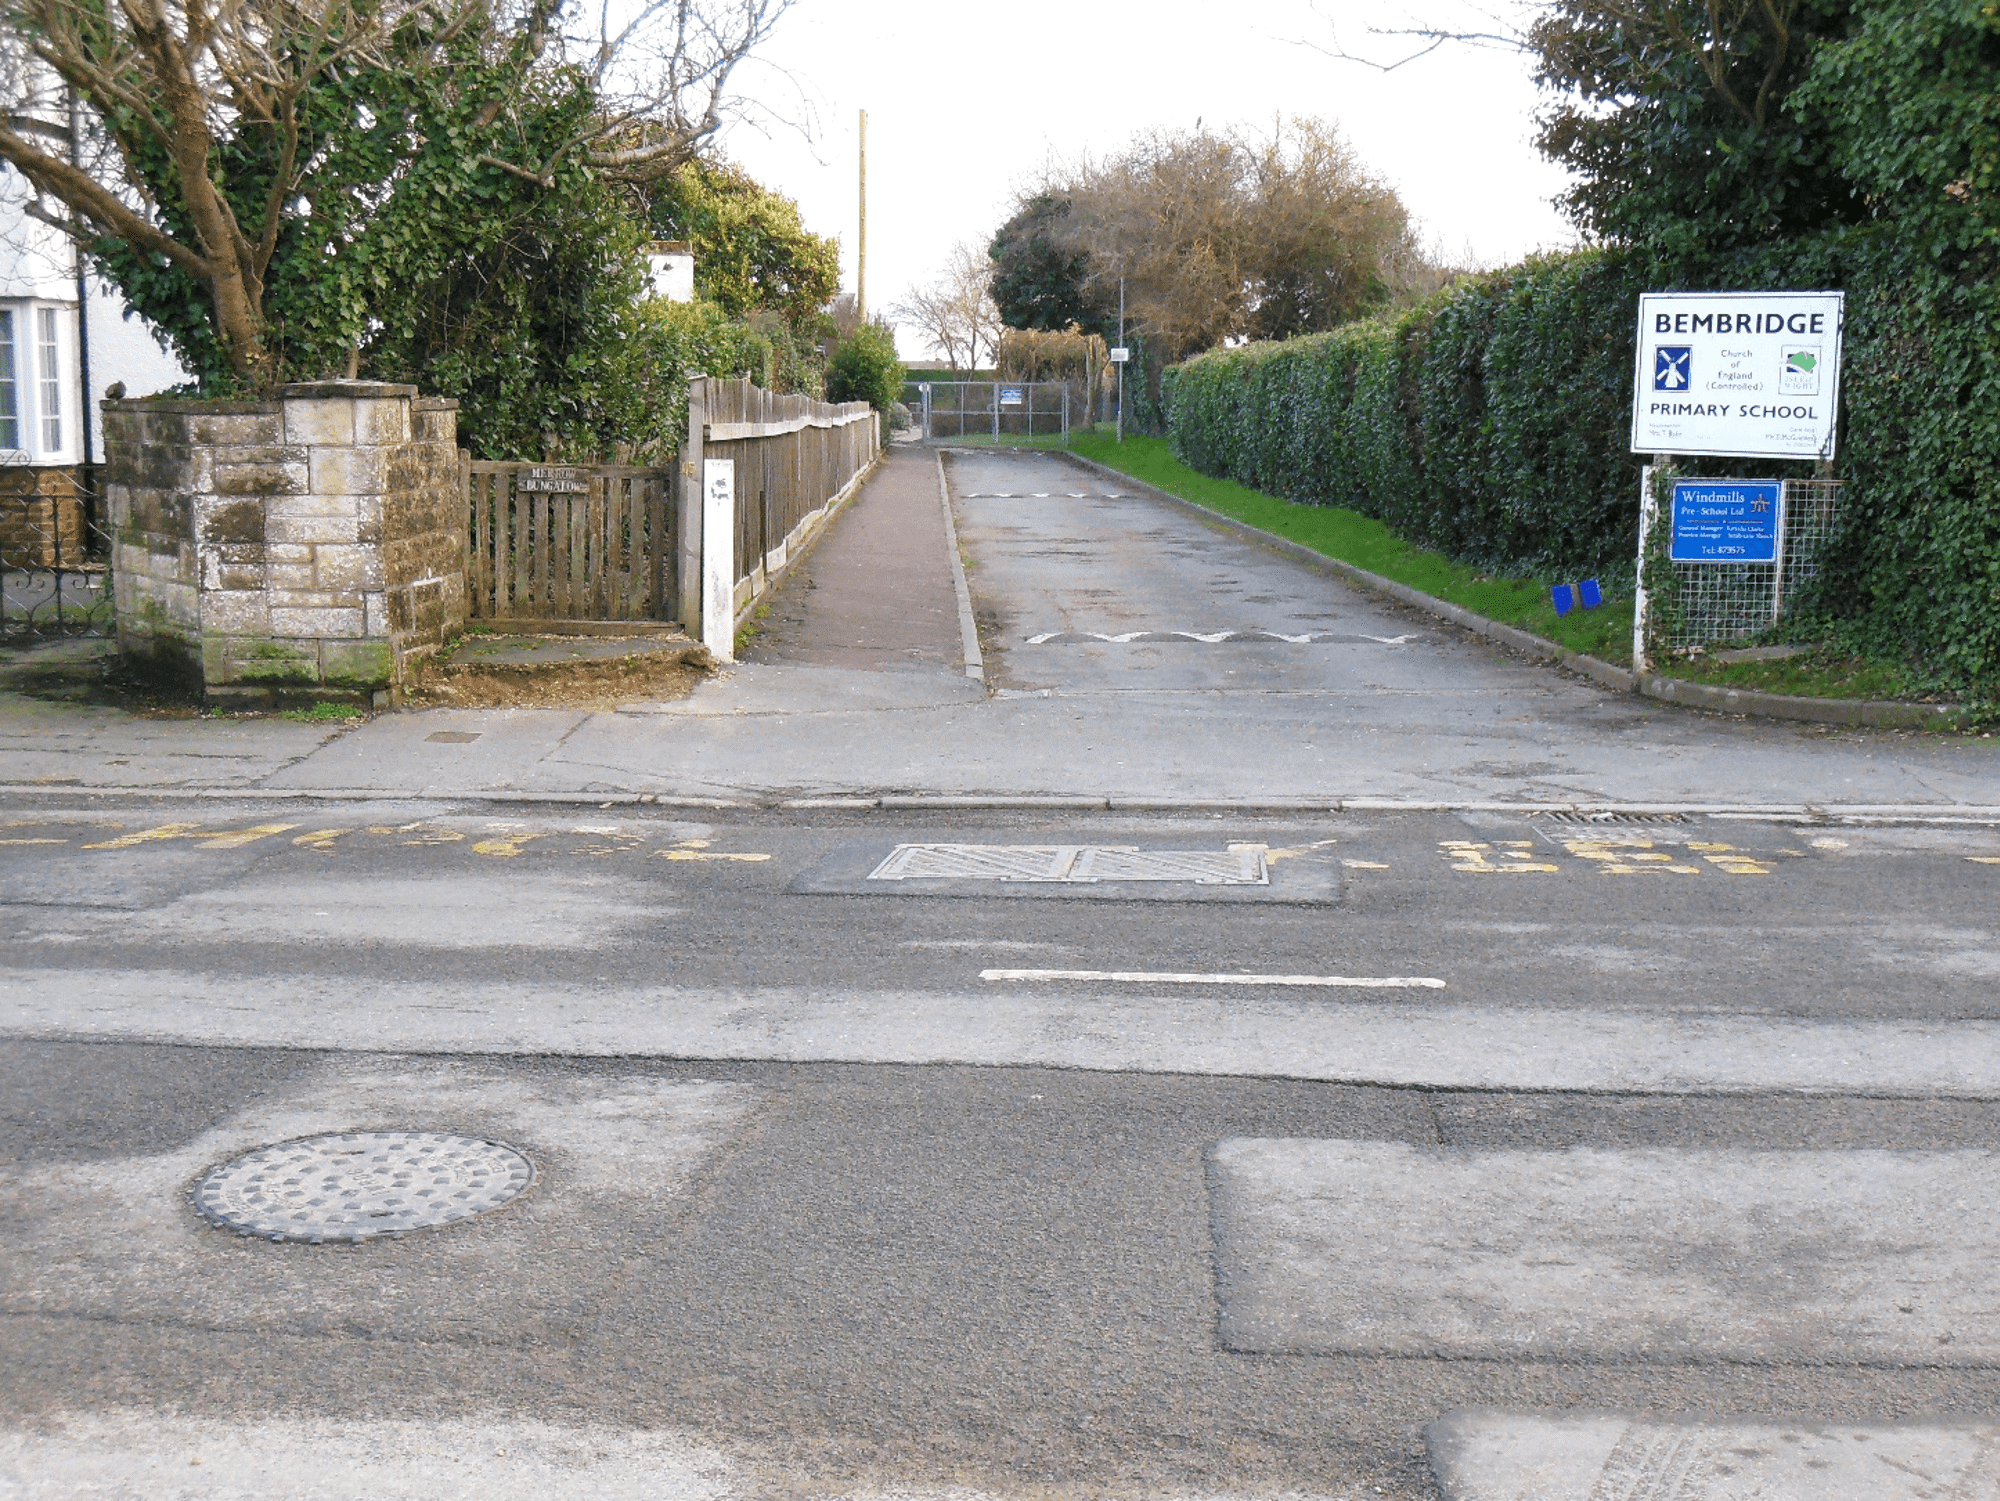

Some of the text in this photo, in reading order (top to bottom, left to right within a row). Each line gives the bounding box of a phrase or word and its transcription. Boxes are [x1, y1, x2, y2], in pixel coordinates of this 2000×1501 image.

[1655, 313, 1825, 334] BEMBRIDGE
[1720, 349, 1753, 358] Church
[1730, 360, 1741, 369] of
[1718, 371, 1753, 381] England
[1705, 381, 1764, 391] (Controlled)
[1650, 403, 1819, 420] PRIMARY SCHOOL
[1682, 490, 1745, 503] Windmills
[1730, 507, 1745, 516] Ltd
